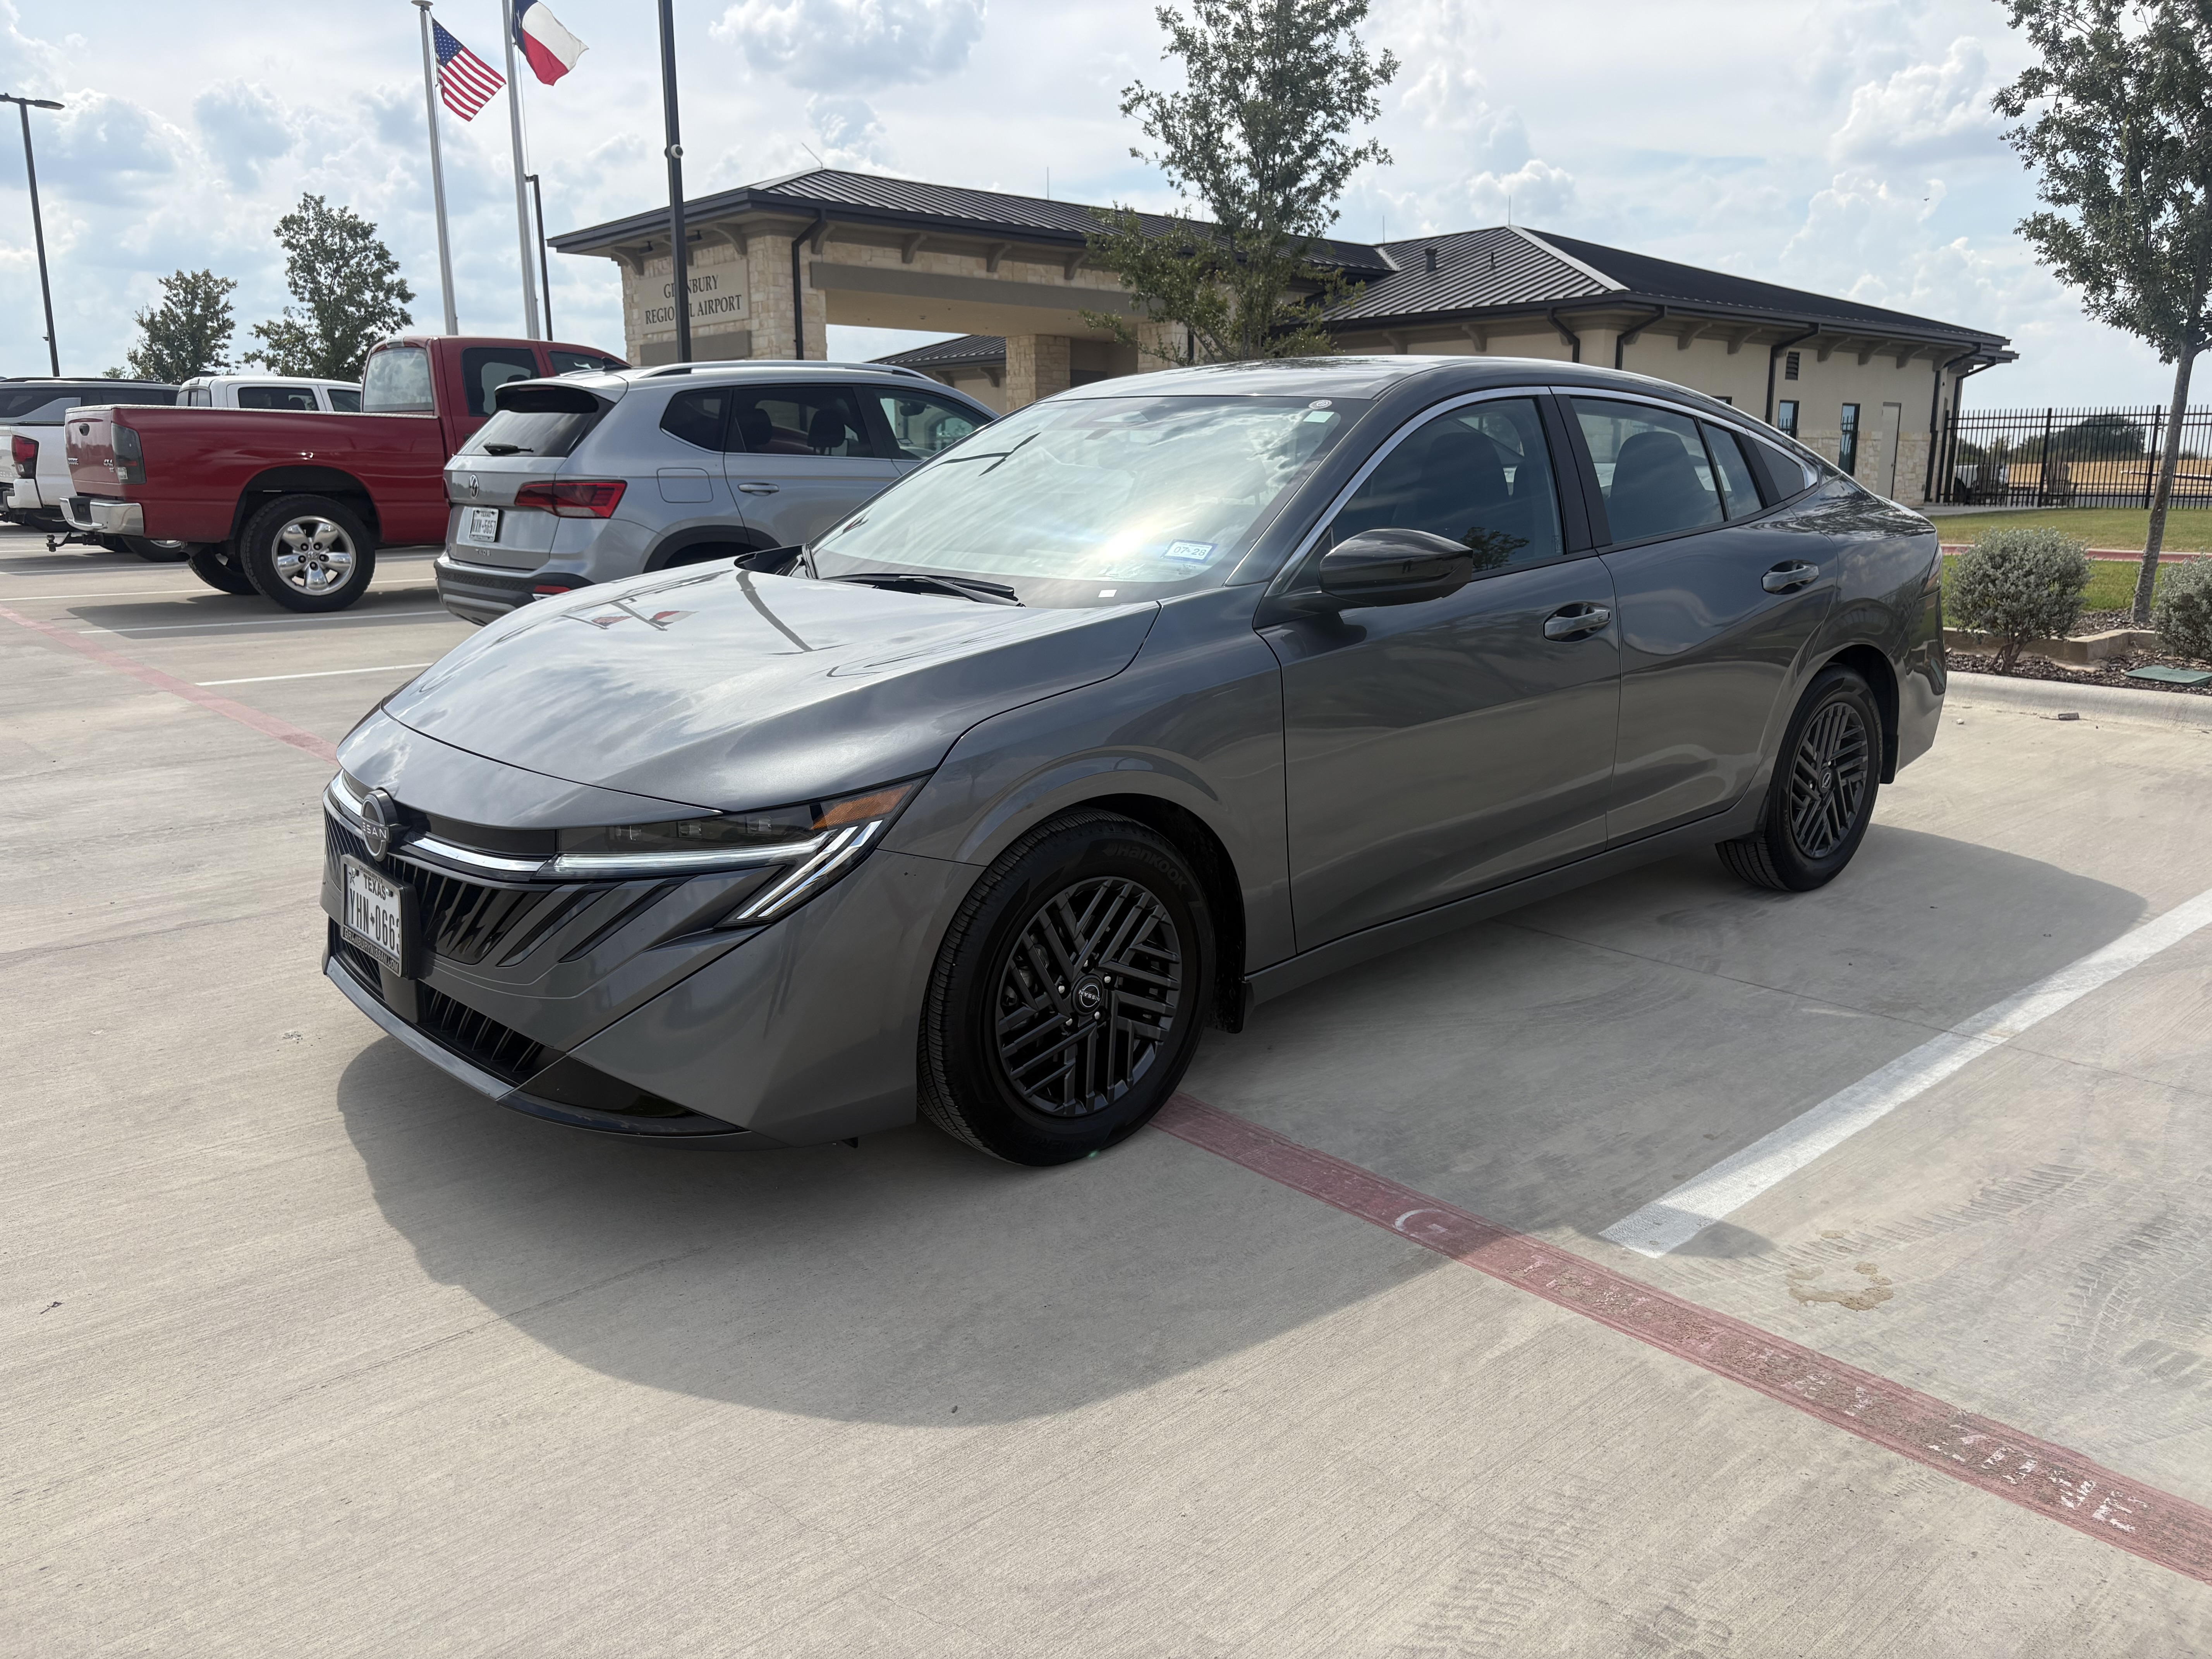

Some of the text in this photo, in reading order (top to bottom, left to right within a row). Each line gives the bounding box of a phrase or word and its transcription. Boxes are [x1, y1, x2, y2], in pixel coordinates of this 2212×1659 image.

[664, 275, 719, 299] GNBURY
[646, 295, 742, 325] REGIOL AIRPORT
[363, 873, 386, 901] TEXAS
[350, 888, 369, 934] YHN
[1079, 988, 1101, 1002] NISSAN
